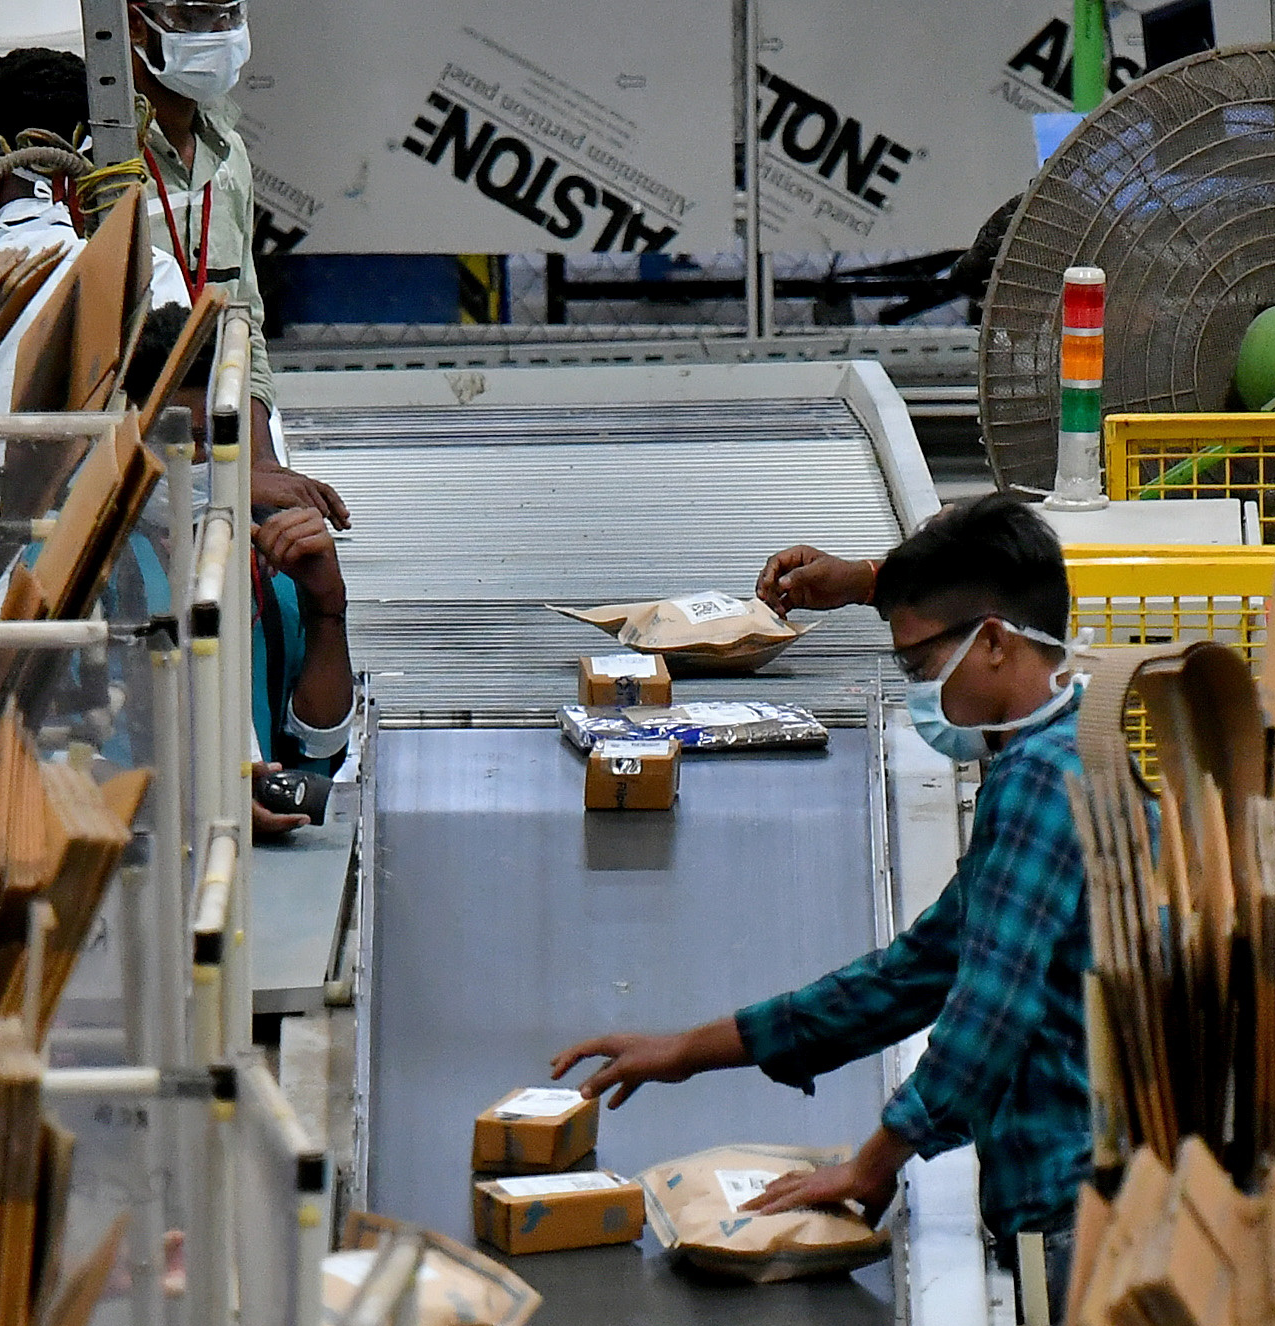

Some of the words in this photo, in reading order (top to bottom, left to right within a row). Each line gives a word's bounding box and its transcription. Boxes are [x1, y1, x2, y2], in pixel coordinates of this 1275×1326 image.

[440, 62, 500, 101] panel
[757, 64, 912, 210] TONE
[403, 91, 679, 254] ALSTONE
